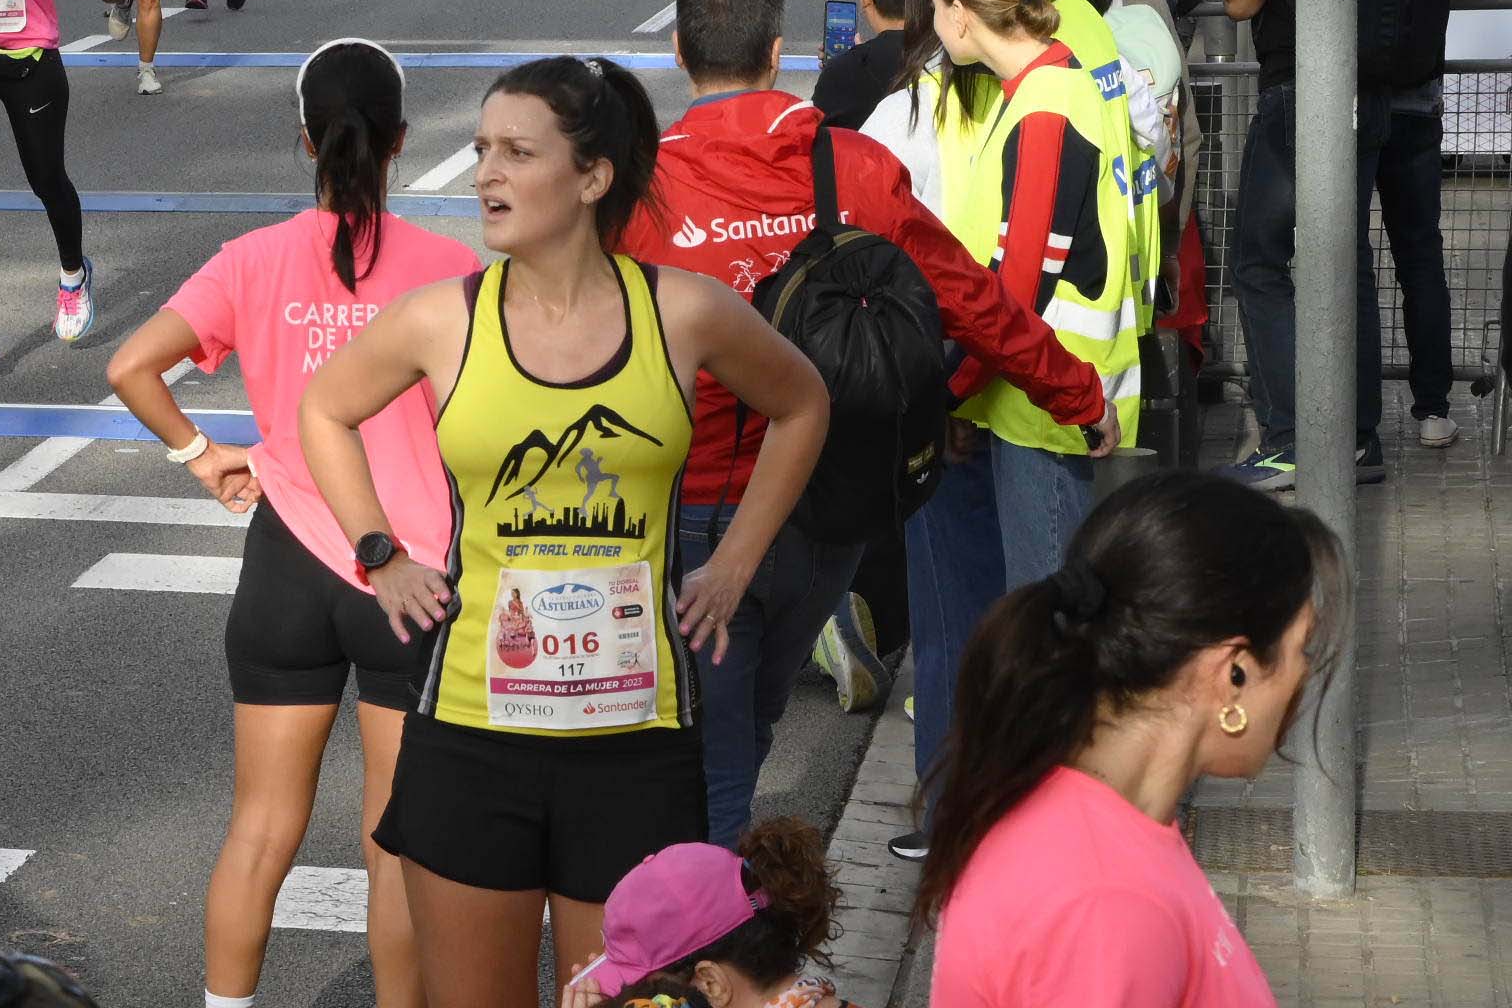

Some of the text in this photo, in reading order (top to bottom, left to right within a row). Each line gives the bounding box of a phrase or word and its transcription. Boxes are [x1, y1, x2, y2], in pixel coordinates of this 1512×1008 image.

[712, 209, 848, 244] Santanr
[284, 302, 380, 327] CARRER
[308, 327, 336, 350] DE
[505, 543, 622, 558] BCN TRAIL RUNNER
[609, 585, 640, 595] SUMA
[538, 598, 600, 612] ASTURIANA
[542, 631, 600, 656] 016
[558, 663, 585, 677] 117
[507, 678, 643, 693] CARRERA DE LA MUJER 2023
[504, 702, 554, 717] OYSHO
[597, 700, 648, 715] Santander
